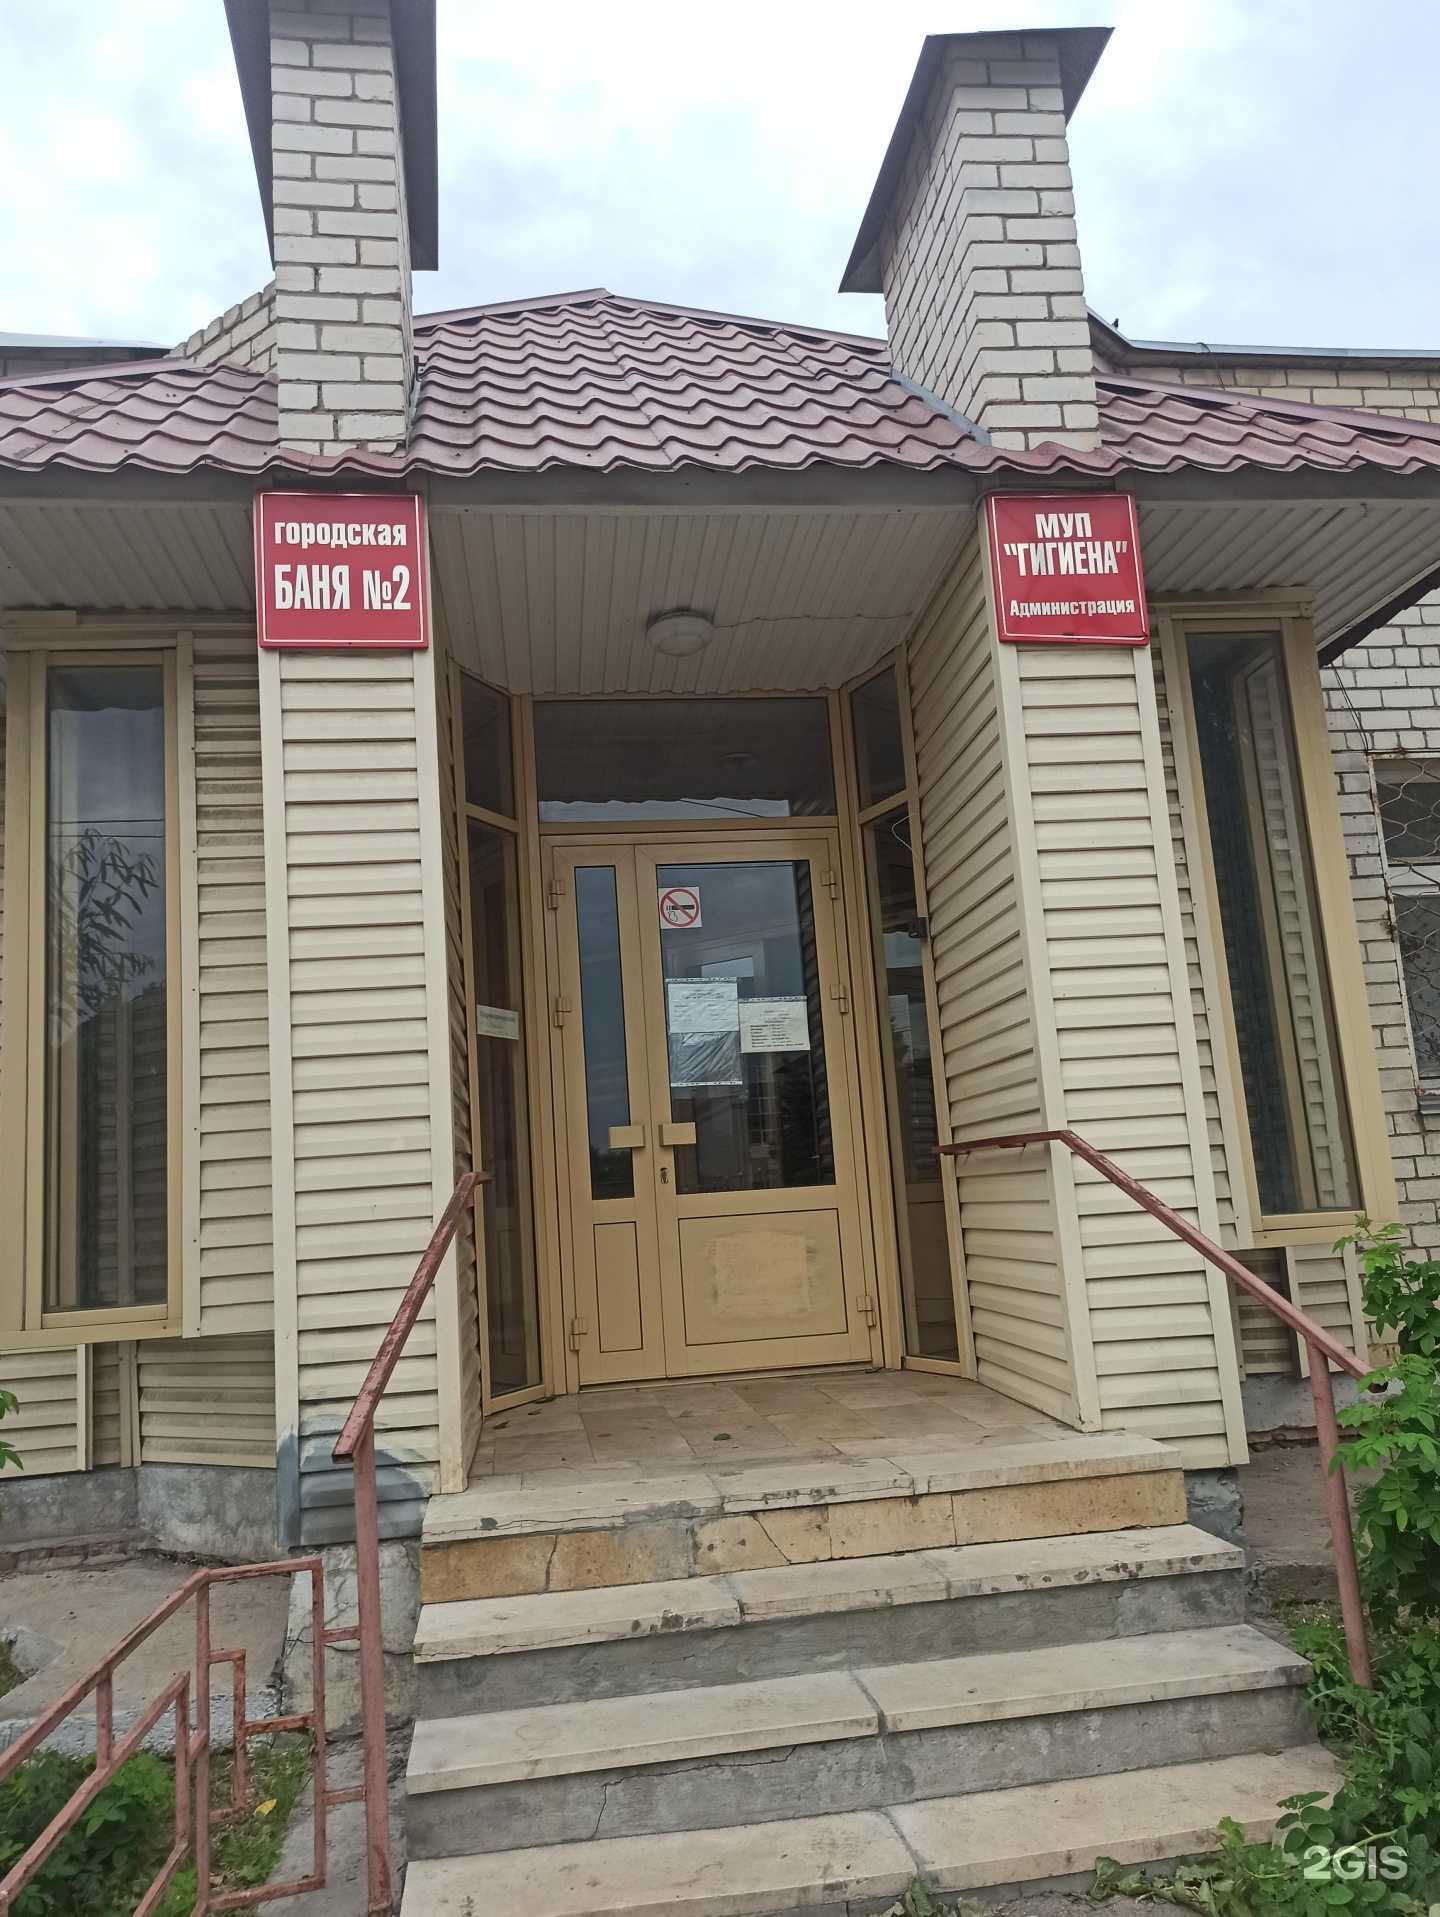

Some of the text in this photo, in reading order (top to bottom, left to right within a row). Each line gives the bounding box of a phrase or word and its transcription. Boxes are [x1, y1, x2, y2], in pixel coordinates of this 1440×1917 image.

[274, 522, 407, 549] городская
[1035, 512, 1092, 538] МУП
[1003, 541, 1128, 577] "ГИГИЕНА"
[274, 564, 412, 610] БАНЯ №2
[1010, 599, 1135, 617] Администрация
